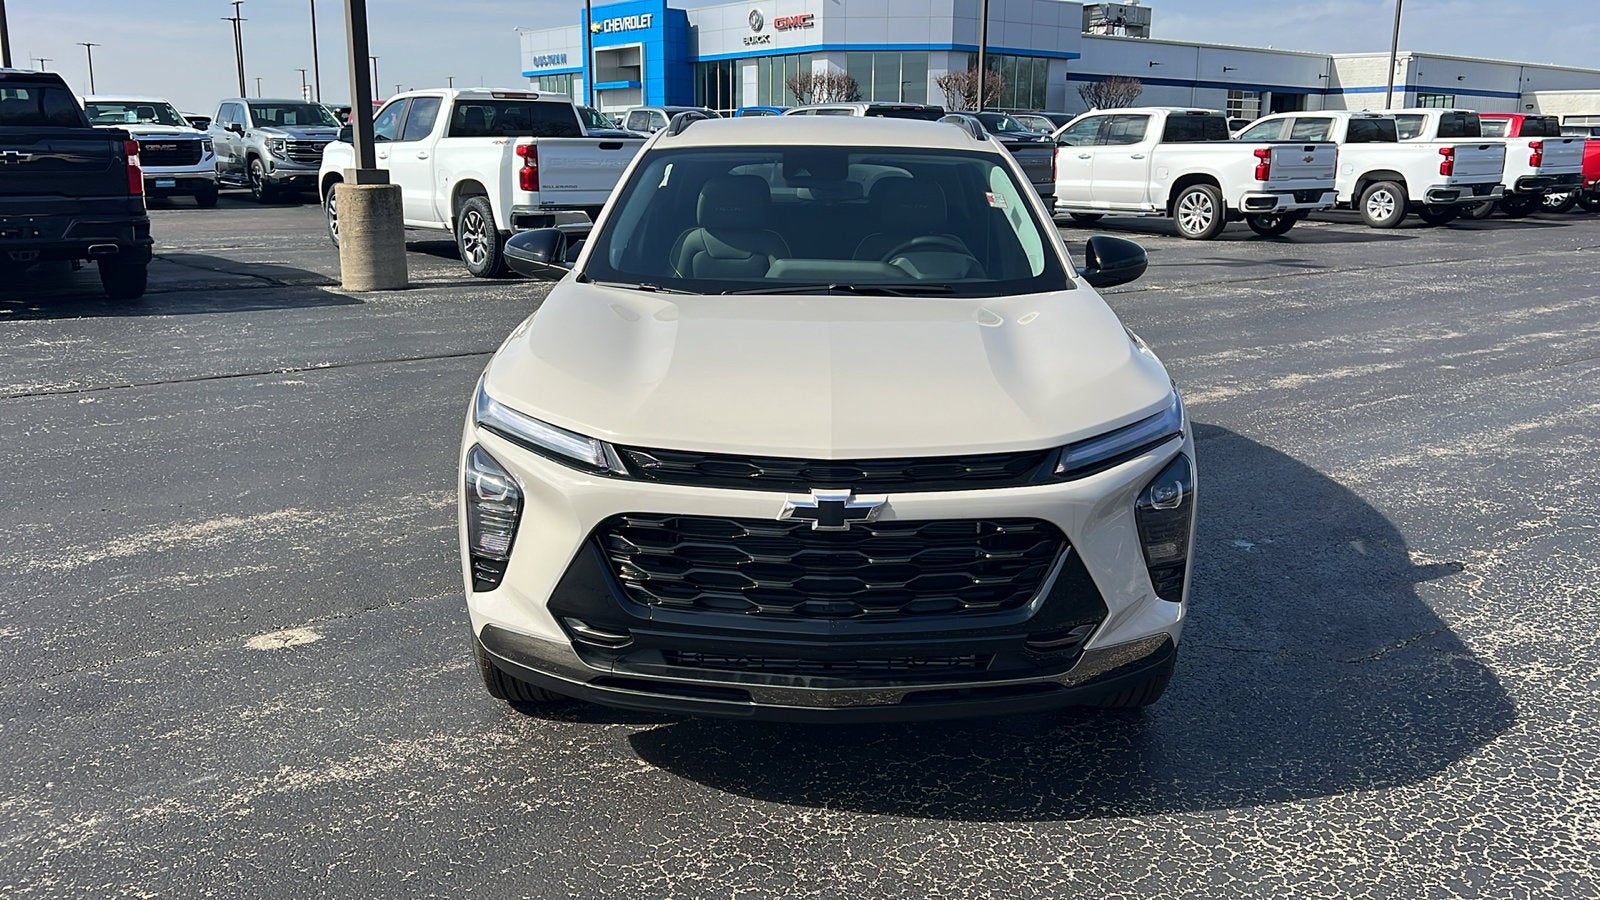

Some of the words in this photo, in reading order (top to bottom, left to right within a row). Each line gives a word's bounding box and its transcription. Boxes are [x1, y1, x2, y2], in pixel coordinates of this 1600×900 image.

[604, 13, 653, 33] CHEVROLET
[774, 13, 814, 32] GMC
[743, 34, 771, 46] BUICK
